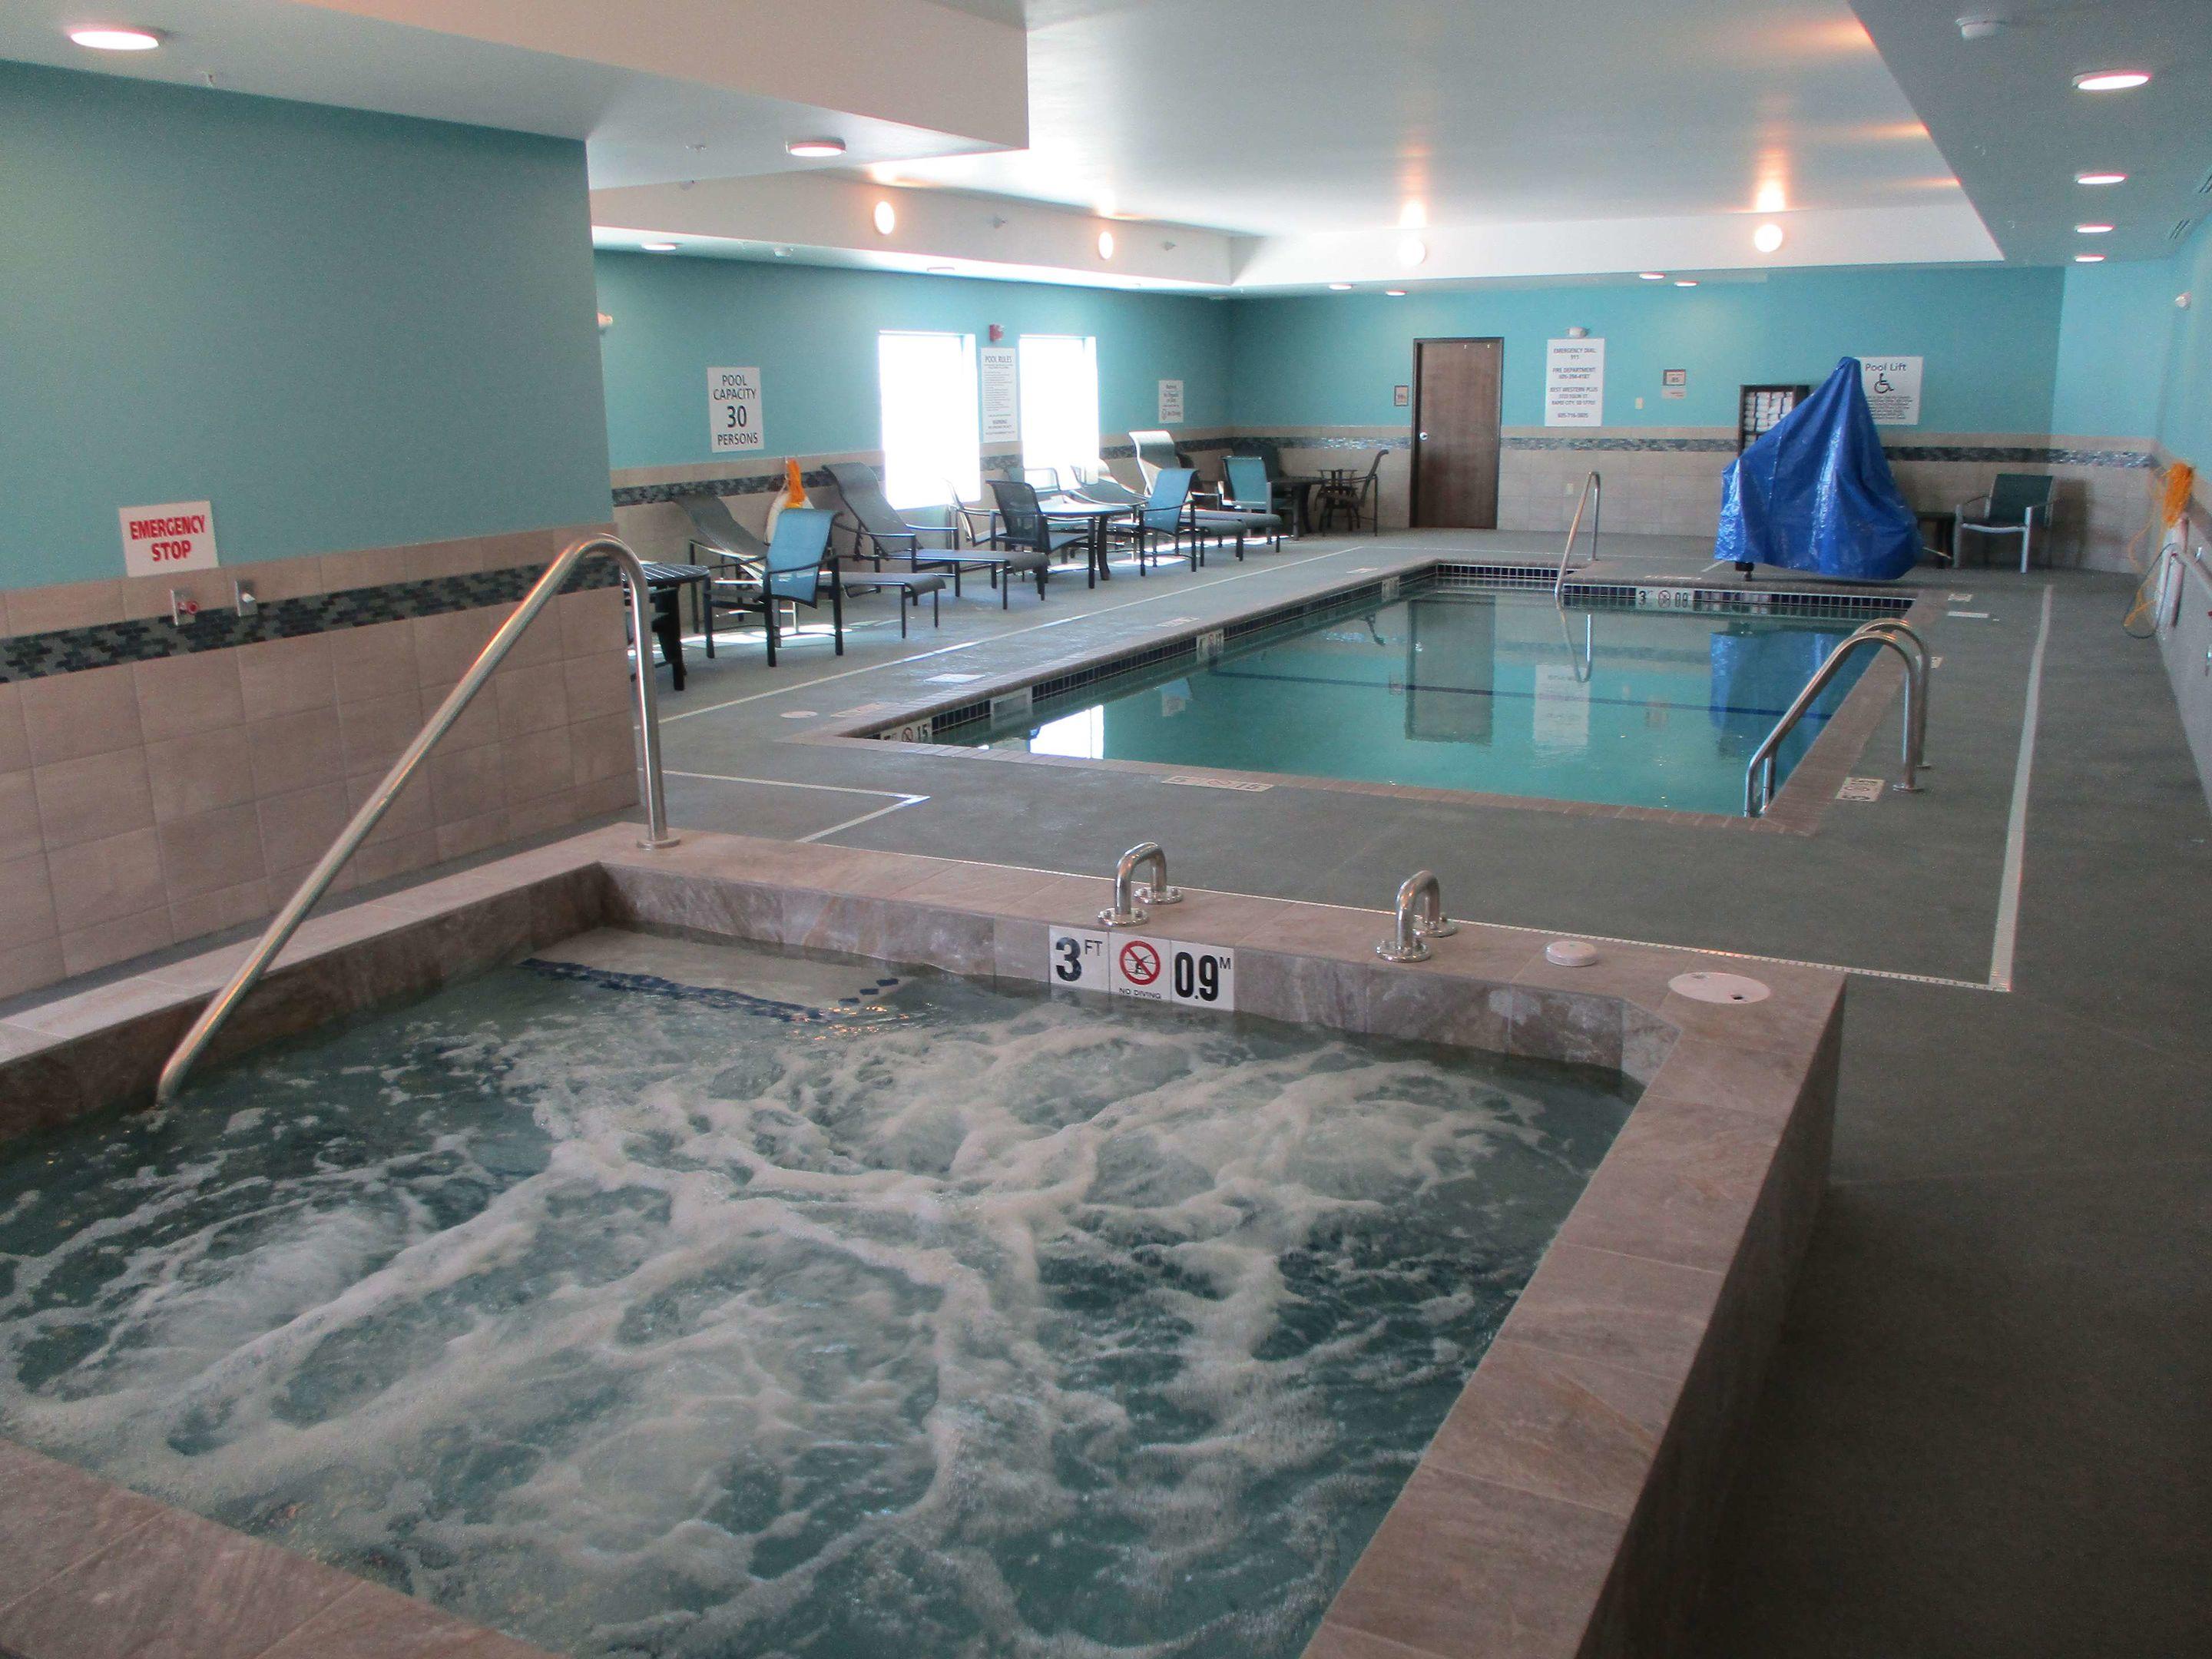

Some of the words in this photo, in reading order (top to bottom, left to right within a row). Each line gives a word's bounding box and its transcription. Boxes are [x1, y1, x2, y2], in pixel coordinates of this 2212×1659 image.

[1866, 363, 1887, 371] Pool
[1890, 363, 1906, 371] Lift
[722, 375, 747, 386] POOL
[714, 388, 757, 399] CAPACITY
[727, 406, 747, 428] 30
[717, 432, 758, 445] PERSONS
[129, 515, 205, 540] EMERGENCY
[151, 540, 191, 561] STOP
[1056, 936, 1082, 982] 3
[1084, 939, 1103, 956] FT
[1220, 956, 1231, 970] M
[1134, 989, 1161, 999] DIVING
